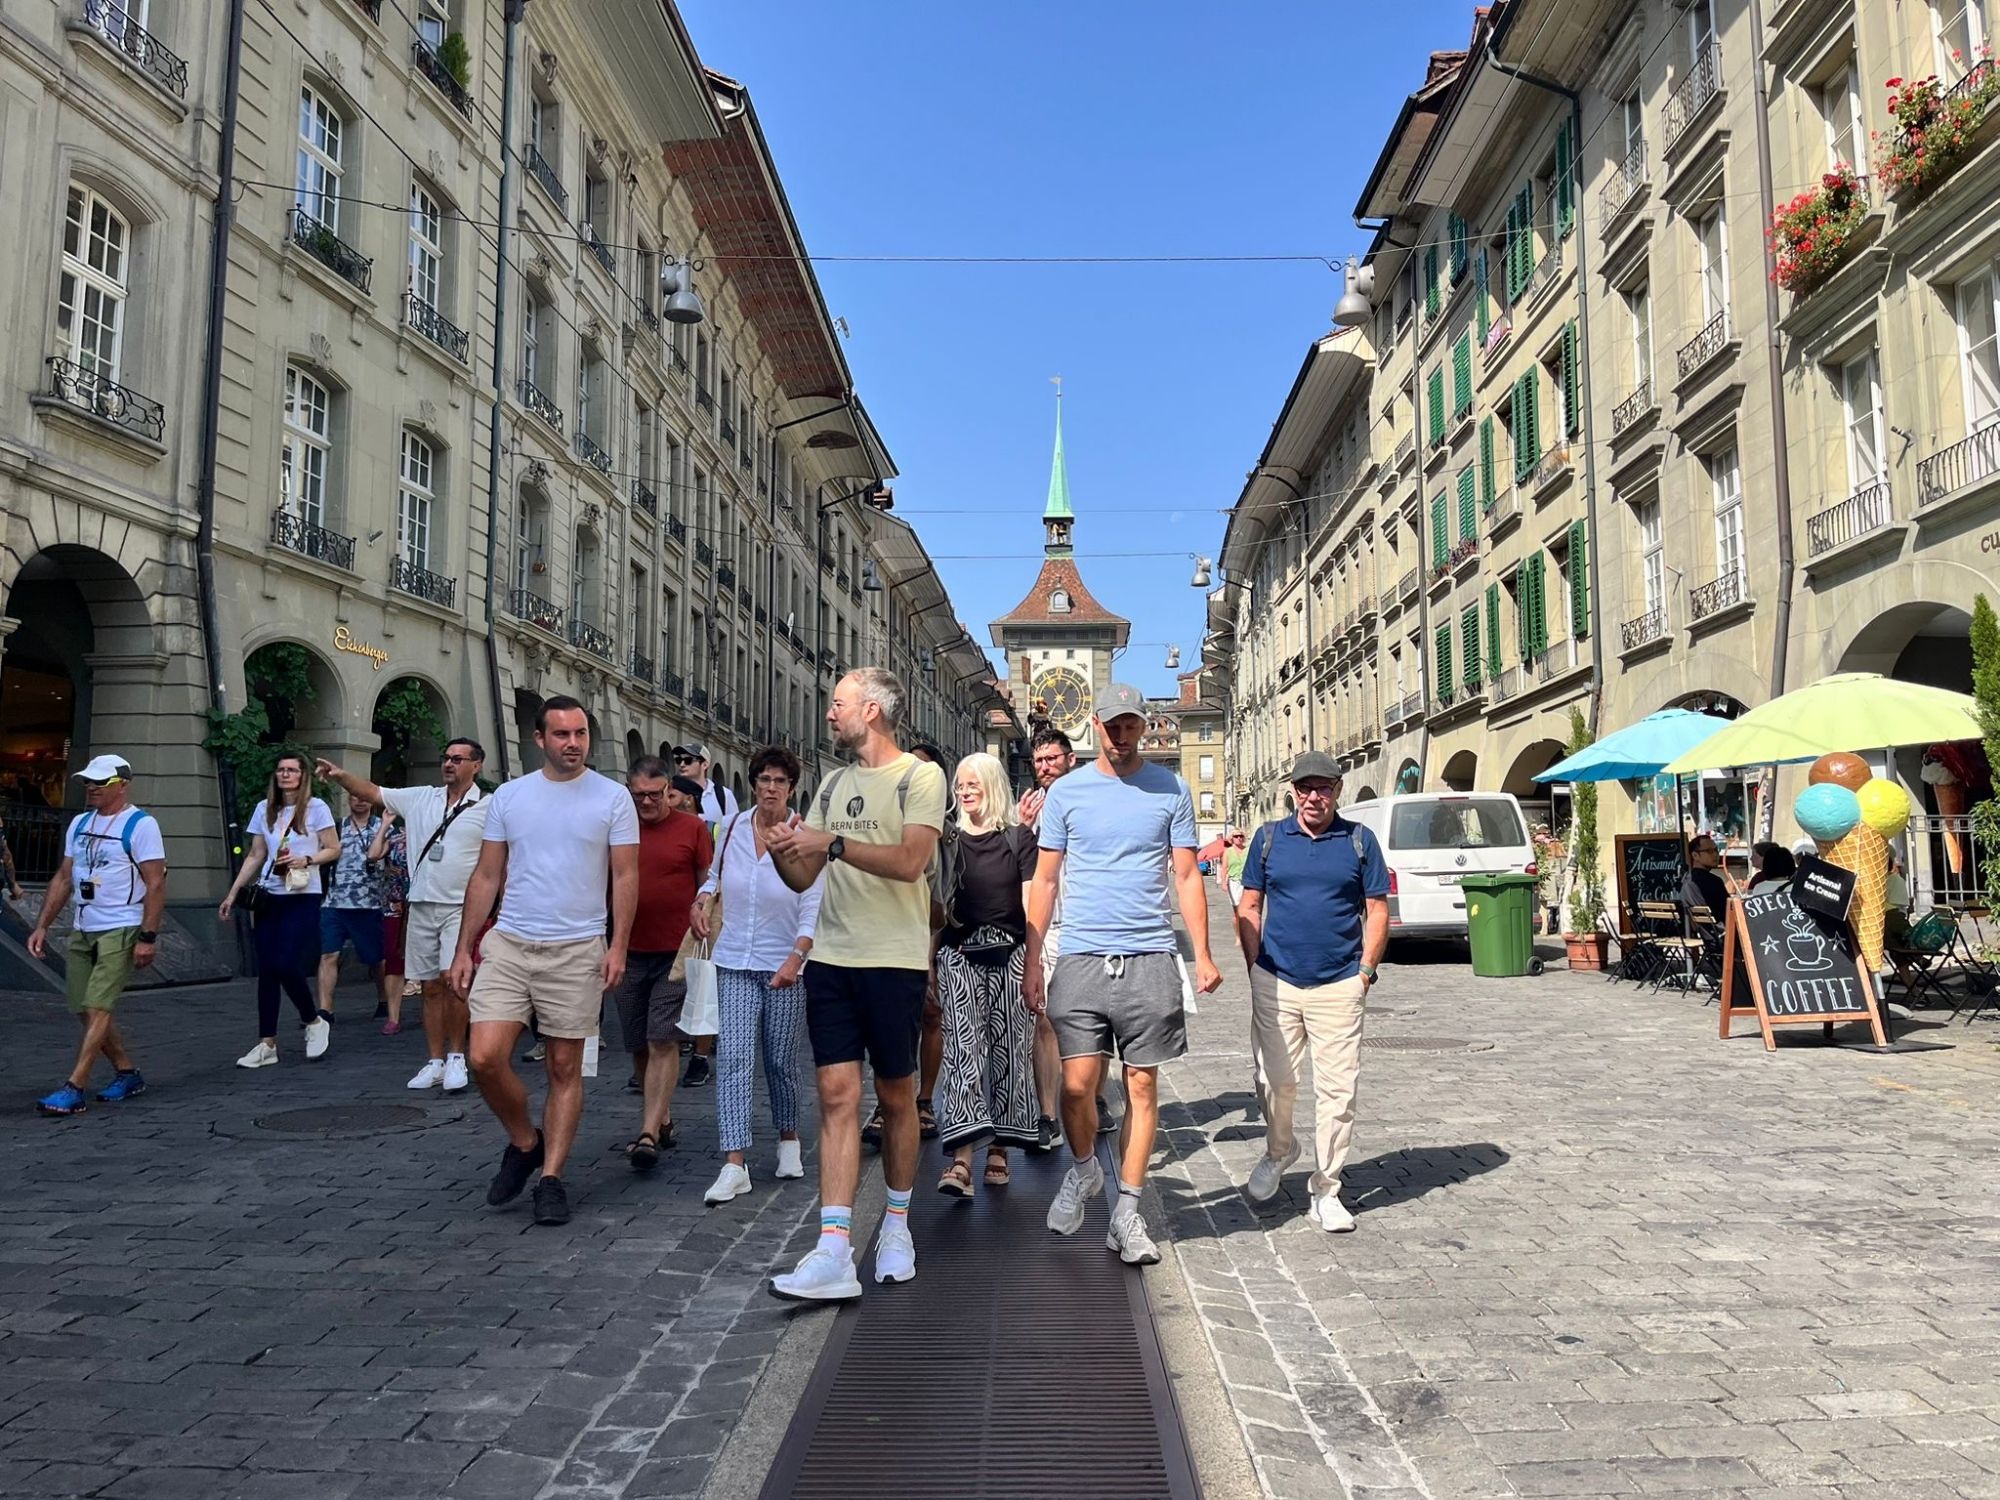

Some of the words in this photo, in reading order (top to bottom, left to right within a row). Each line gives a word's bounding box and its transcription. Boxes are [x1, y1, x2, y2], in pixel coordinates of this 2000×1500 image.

[830, 821, 853, 831] BERN
[854, 820, 878, 830] BITES
[1627, 847, 1681, 873] Artisanal
[1804, 881, 1816, 892] Ice
[1816, 886, 1841, 902] Cream
[1807, 872, 1842, 891] Artisanal
[1766, 977, 1862, 1015] COFFEE
